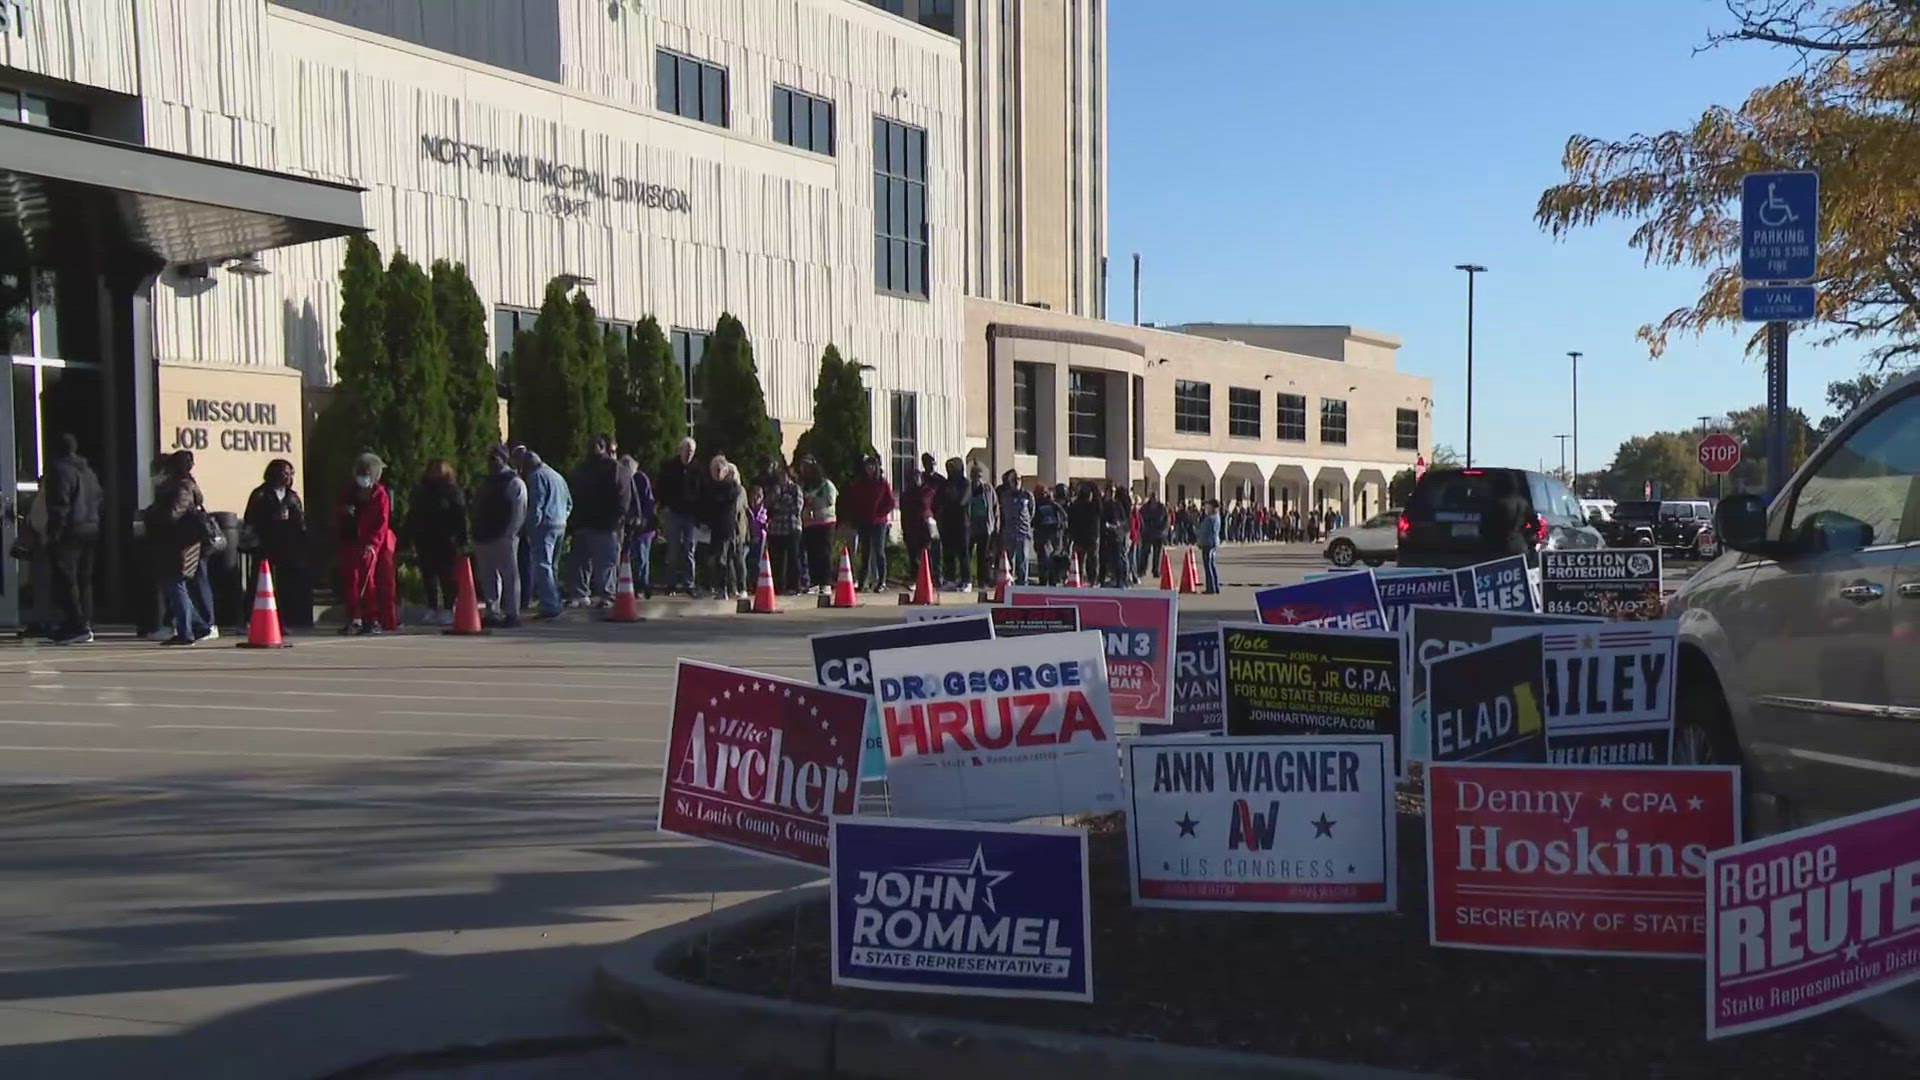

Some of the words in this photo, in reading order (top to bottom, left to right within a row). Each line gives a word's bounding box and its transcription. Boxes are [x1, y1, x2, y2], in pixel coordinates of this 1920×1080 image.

[421, 133, 500, 175] NORTH
[502, 153, 609, 198] MUNICIPAL
[612, 176, 692, 214] DIVISION
[1753, 229, 1804, 245] PARKING
[1770, 246, 1780, 258] TO
[1785, 246, 1809, 258] $300
[1768, 260, 1787, 271] FINE
[1766, 292, 1791, 304] VAN
[187, 398, 276, 425] MISSOURI
[172, 426, 208, 450] JOB
[220, 429, 292, 453] CENTER
[1701, 445, 1737, 462] STOP
[1547, 554, 1626, 567] ELECTION
[1547, 567, 1626, 579] PROTECTION
[1496, 568, 1521, 585] JOE
[1134, 633, 1150, 656] 3
[1229, 634, 1268, 649] Vote
[1289, 652, 1318, 661] JOHN
[880, 674, 936, 702] DR.
[943, 661, 1081, 696] GEORGE
[1110, 679, 1141, 689] BAN
[1229, 660, 1317, 690] HARTWIG,
[1322, 671, 1339, 688] JR
[1345, 667, 1396, 692] C.P.A.
[1234, 684, 1256, 697] FOR
[1260, 687, 1277, 699] MO
[1281, 688, 1315, 701] STATE
[1319, 690, 1390, 708] TREASURER
[719, 717, 767, 743] Mike
[883, 690, 1107, 758] HRUZA
[1249, 710, 1375, 730] JOHNHARTWIGCPA.COM
[1437, 696, 1513, 754] ELAD
[673, 711, 849, 816] Archer
[1589, 742, 1655, 764] GENERAL
[1153, 751, 1214, 793] ANN
[1225, 751, 1359, 793] WAGNER
[1456, 781, 1583, 823] Denny
[1622, 793, 1678, 813] CPA
[676, 798, 693, 819] St.
[697, 801, 732, 827] Louis
[736, 808, 781, 841] County
[1456, 825, 1707, 879] Hoskins
[1224, 858, 1335, 878] CONGRESS
[1720, 844, 1837, 906] Renee
[854, 870, 976, 912] JOHN
[853, 907, 1072, 957] ROMMEL
[1456, 907, 1585, 932] SECRETARY
[1594, 913, 1626, 931] OF
[1634, 914, 1704, 934] STATE
[866, 951, 911, 967] STATE
[916, 954, 1052, 974] REPRESENTATIVE
[1721, 994, 1763, 1017] State
[1771, 961, 1881, 1007] Representative
